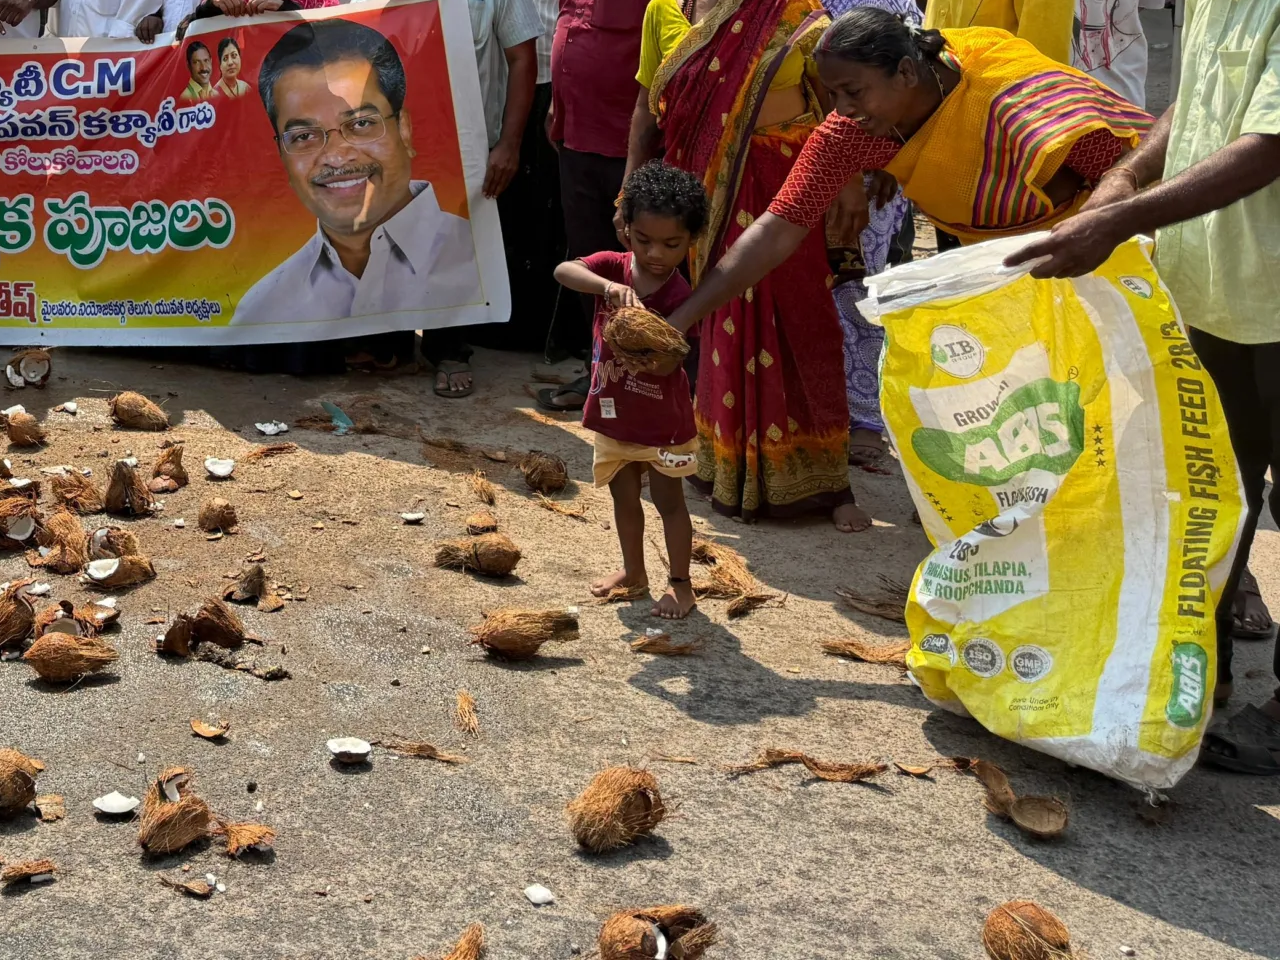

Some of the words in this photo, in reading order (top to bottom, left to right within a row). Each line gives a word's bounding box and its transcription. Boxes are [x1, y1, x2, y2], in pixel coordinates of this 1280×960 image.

[52, 61, 132, 96] C.M
[179, 105, 213, 129] గారు
[4, 149, 136, 171] కోలుకోవాలని
[47, 196, 232, 266] పూజలు
[41, 301, 77, 321] మైలవరం
[128, 301, 153, 316] తెలుగు
[155, 300, 185, 316] యువత
[945, 340, 975, 359] IB
[1177, 377, 1211, 439] FEED
[964, 402, 1071, 476] ABIS
[1184, 445, 1220, 502] FISH
[1177, 507, 1218, 619] FLOATING
[934, 578, 1025, 601] ROOPCHANDA
[969, 650, 992, 660] ISO
[1015, 657, 1042, 668] GMP
